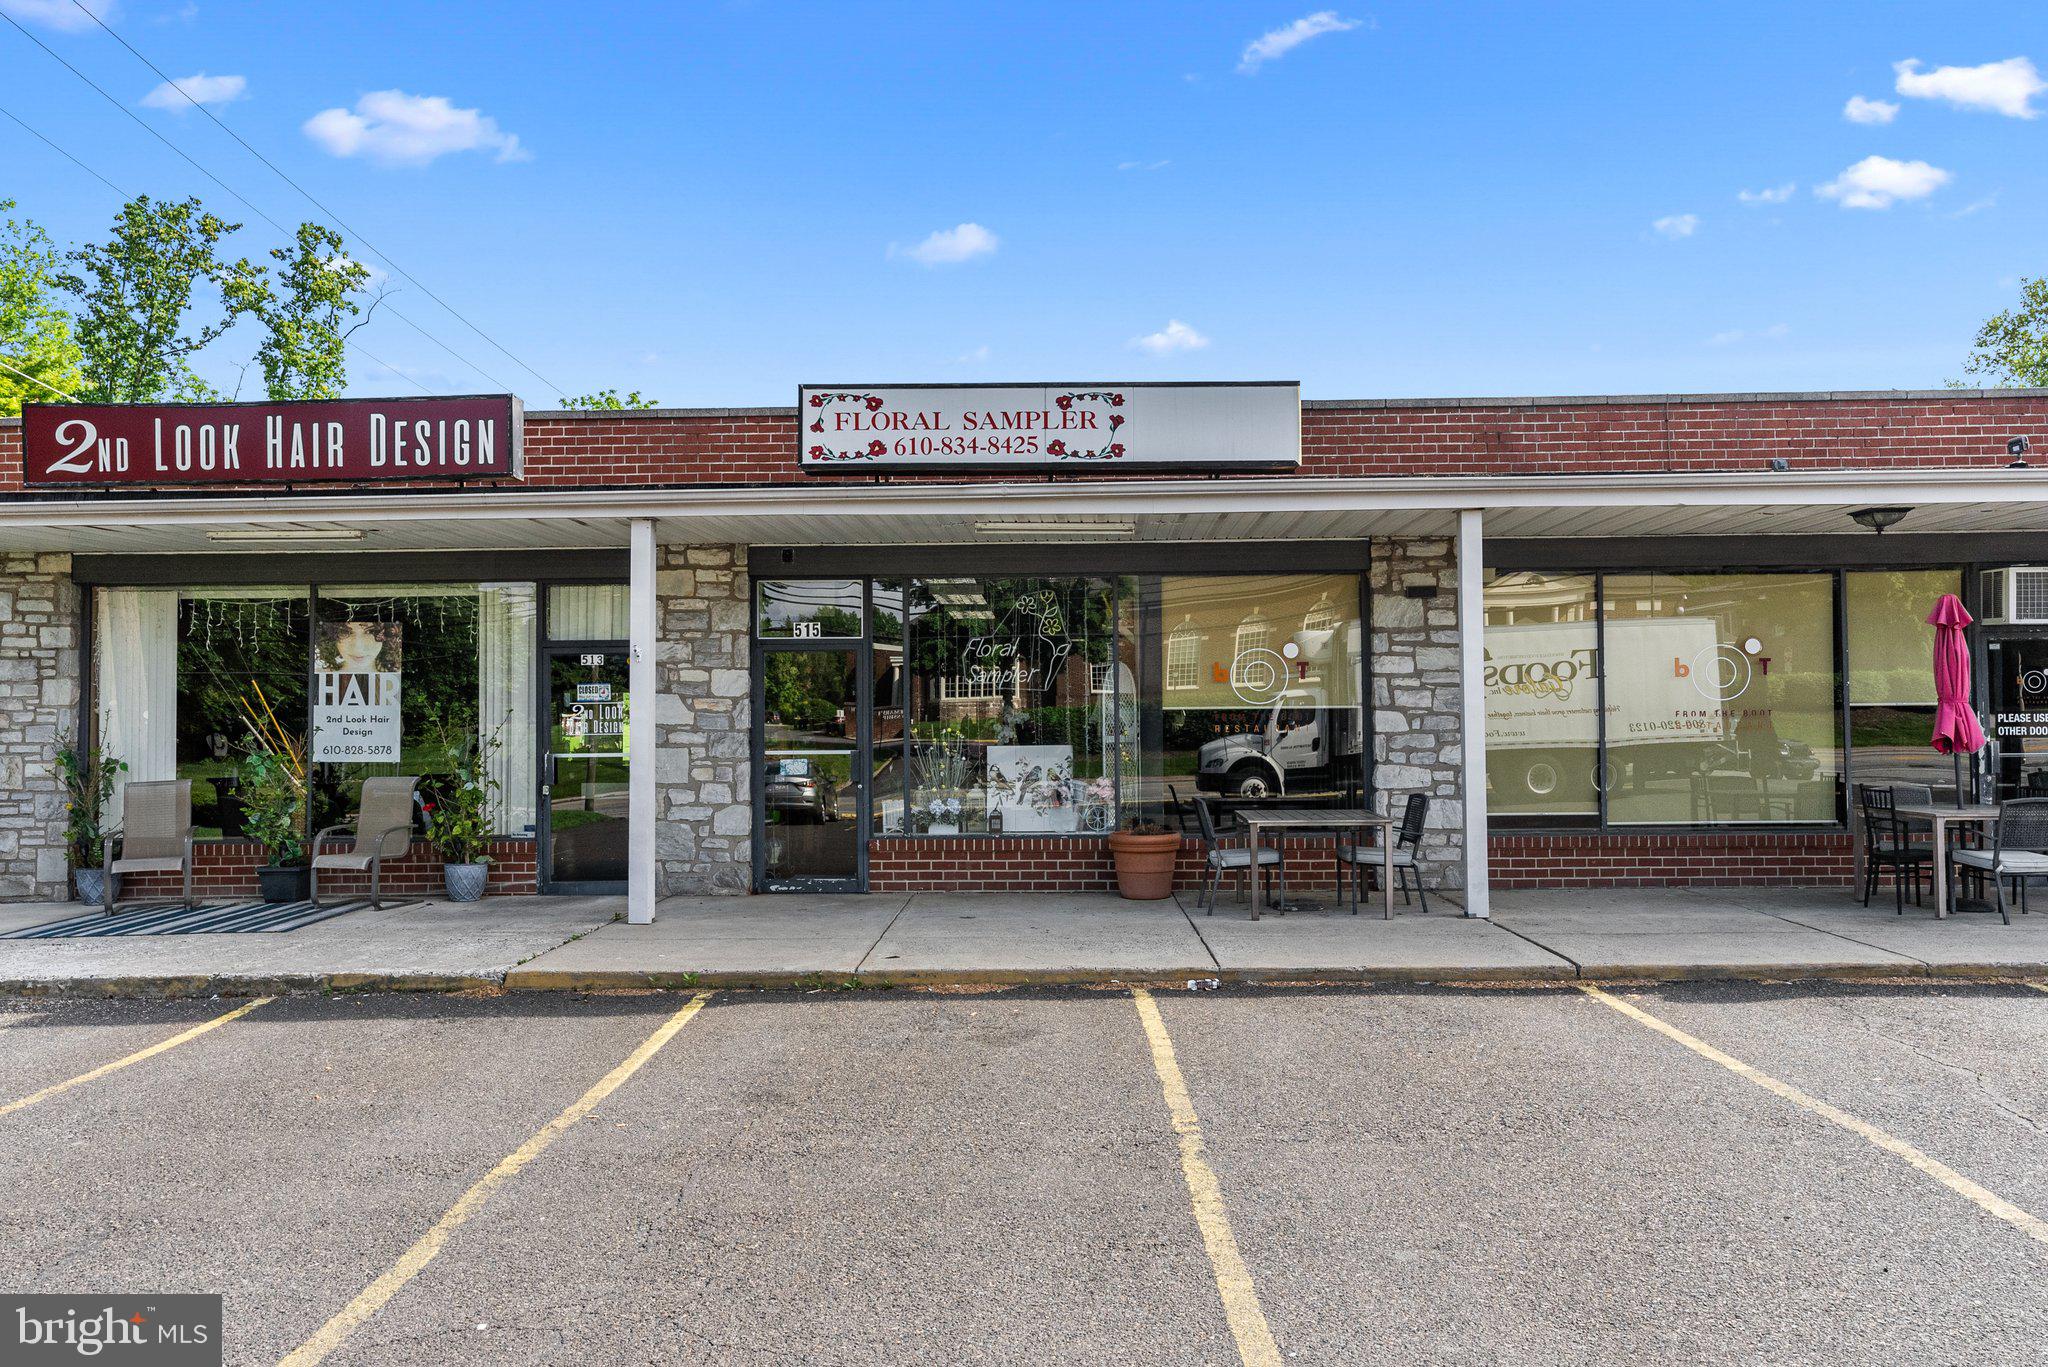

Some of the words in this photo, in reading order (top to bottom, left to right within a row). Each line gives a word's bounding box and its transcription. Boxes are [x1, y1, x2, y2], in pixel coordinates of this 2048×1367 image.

[834, 411, 951, 432] FLORAL
[962, 410, 1099, 431] SAMPLER
[154, 417, 241, 472] LOOK
[266, 414, 345, 469] HAIR
[370, 412, 495, 468] DESIGN
[894, 435, 1039, 457] 610-834-8425
[794, 622, 820, 637] 515
[964, 637, 1020, 658] Floral
[581, 655, 603, 665] 513
[970, 665, 1041, 689] Sampler
[319, 673, 400, 706] HAIR
[578, 685, 598, 694] CLOSED
[326, 715, 342, 723] 2nd
[345, 714, 367, 723] Look
[370, 715, 390, 723] Hair
[1997, 713, 2031, 723] PLEASE
[2033, 713, 2048, 723] USE
[342, 727, 373, 737] Design
[1998, 726, 2027, 735] OTHER
[322, 745, 392, 755] 610-828-5878
